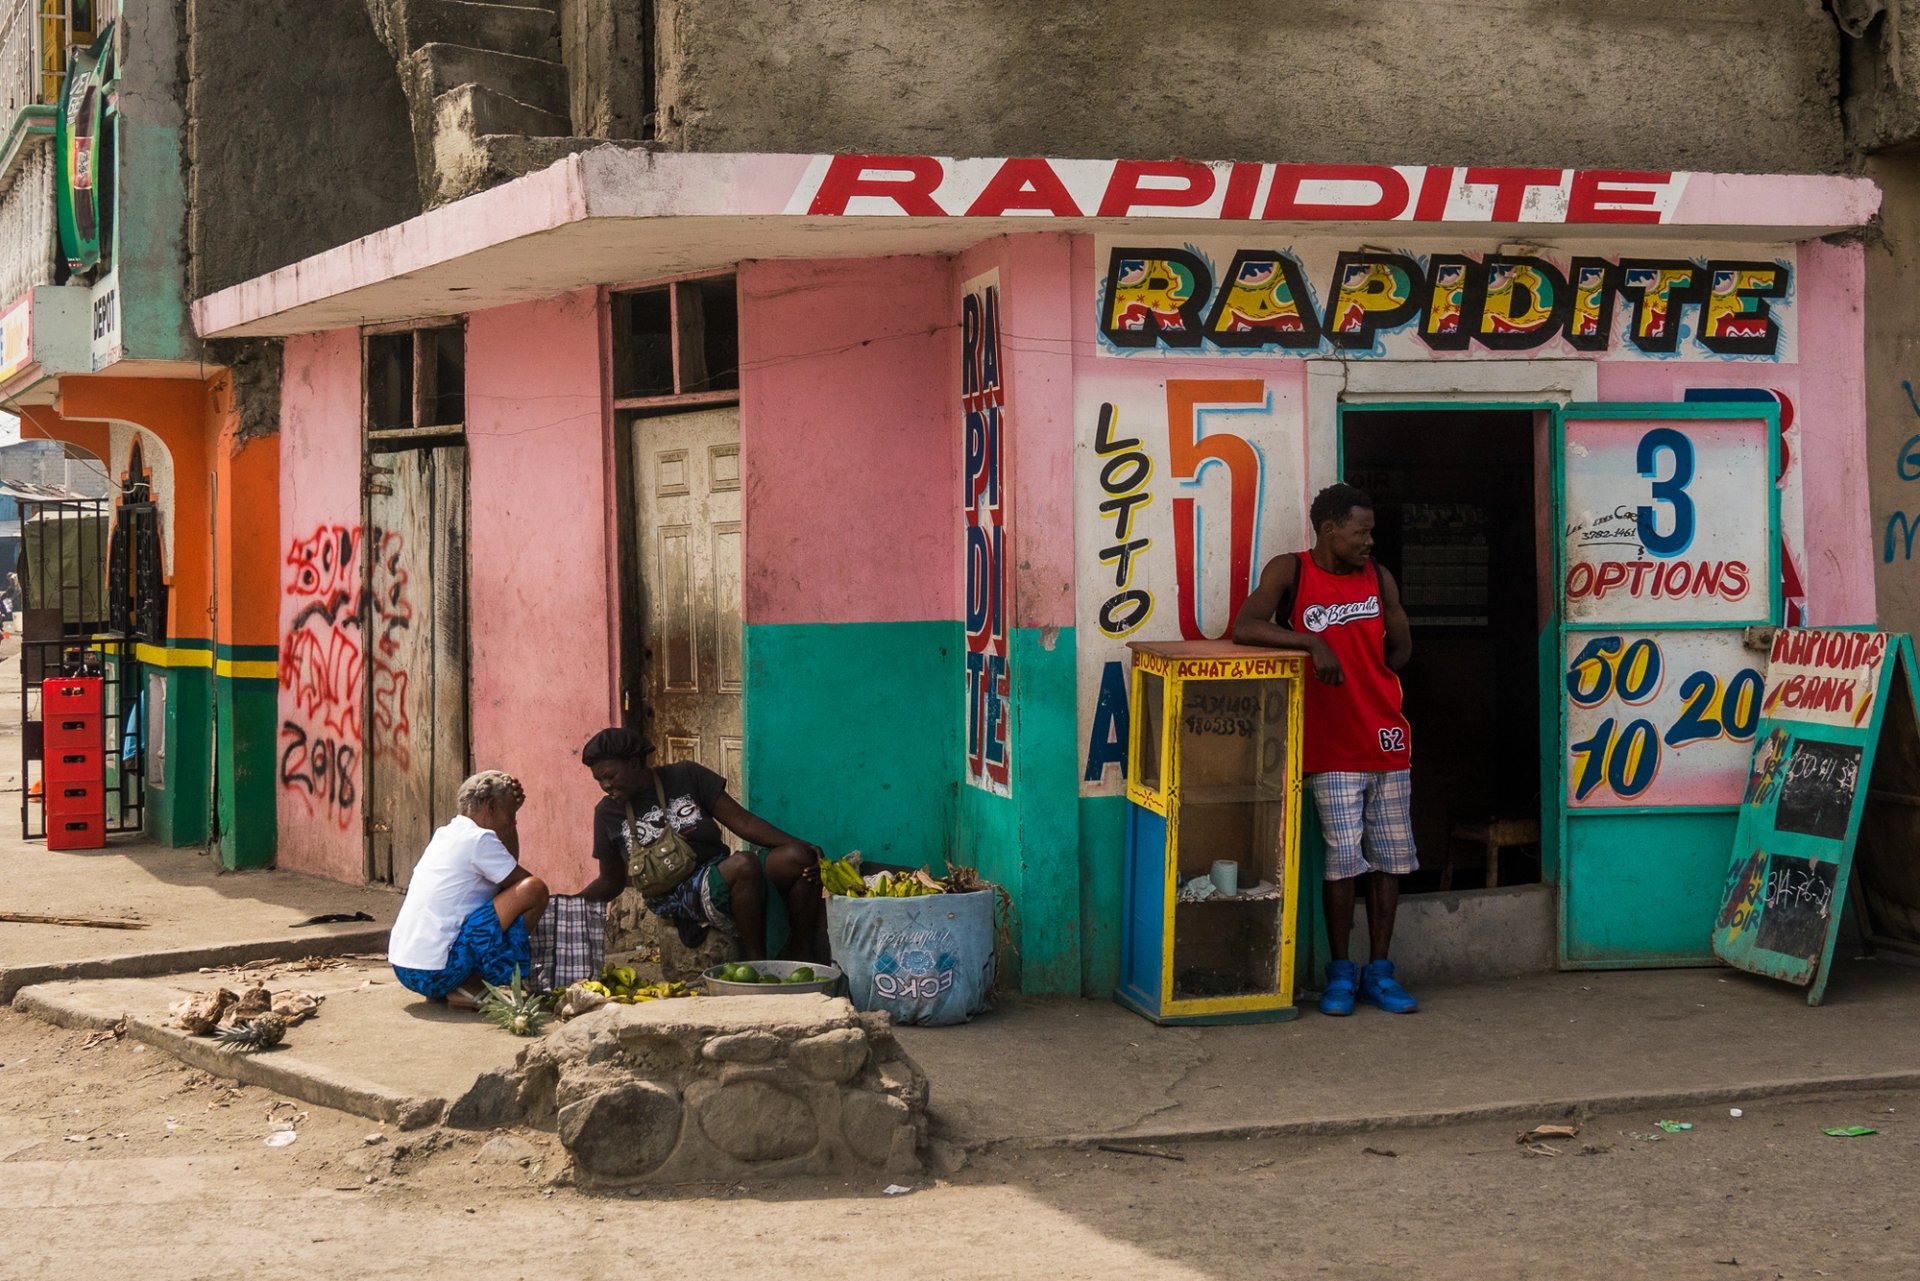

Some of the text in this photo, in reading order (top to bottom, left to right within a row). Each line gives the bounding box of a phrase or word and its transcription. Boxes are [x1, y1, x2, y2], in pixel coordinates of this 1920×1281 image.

[807, 154, 1672, 224] RAPIDITE
[1100, 247, 1790, 355] RAPIDITE
[1095, 402, 1152, 636] LOTTO
[1637, 428, 1696, 558] 3
[1327, 596, 1378, 622] Bacardi
[1565, 561, 1749, 602] OPTIONS
[1135, 651, 1169, 677] BIJOUX
[1178, 658, 1300, 678] ACHAT & VENTE
[1567, 636, 1664, 707] 50
[1771, 629, 1884, 670] RAPIDITE
[1664, 668, 1764, 746] 20
[1781, 674, 1857, 713] BANK
[1378, 727, 1404, 752] 62
[1571, 718, 1662, 801] 10
[1752, 732, 1792, 757] NW
[281, 721, 355, 816] 2018
